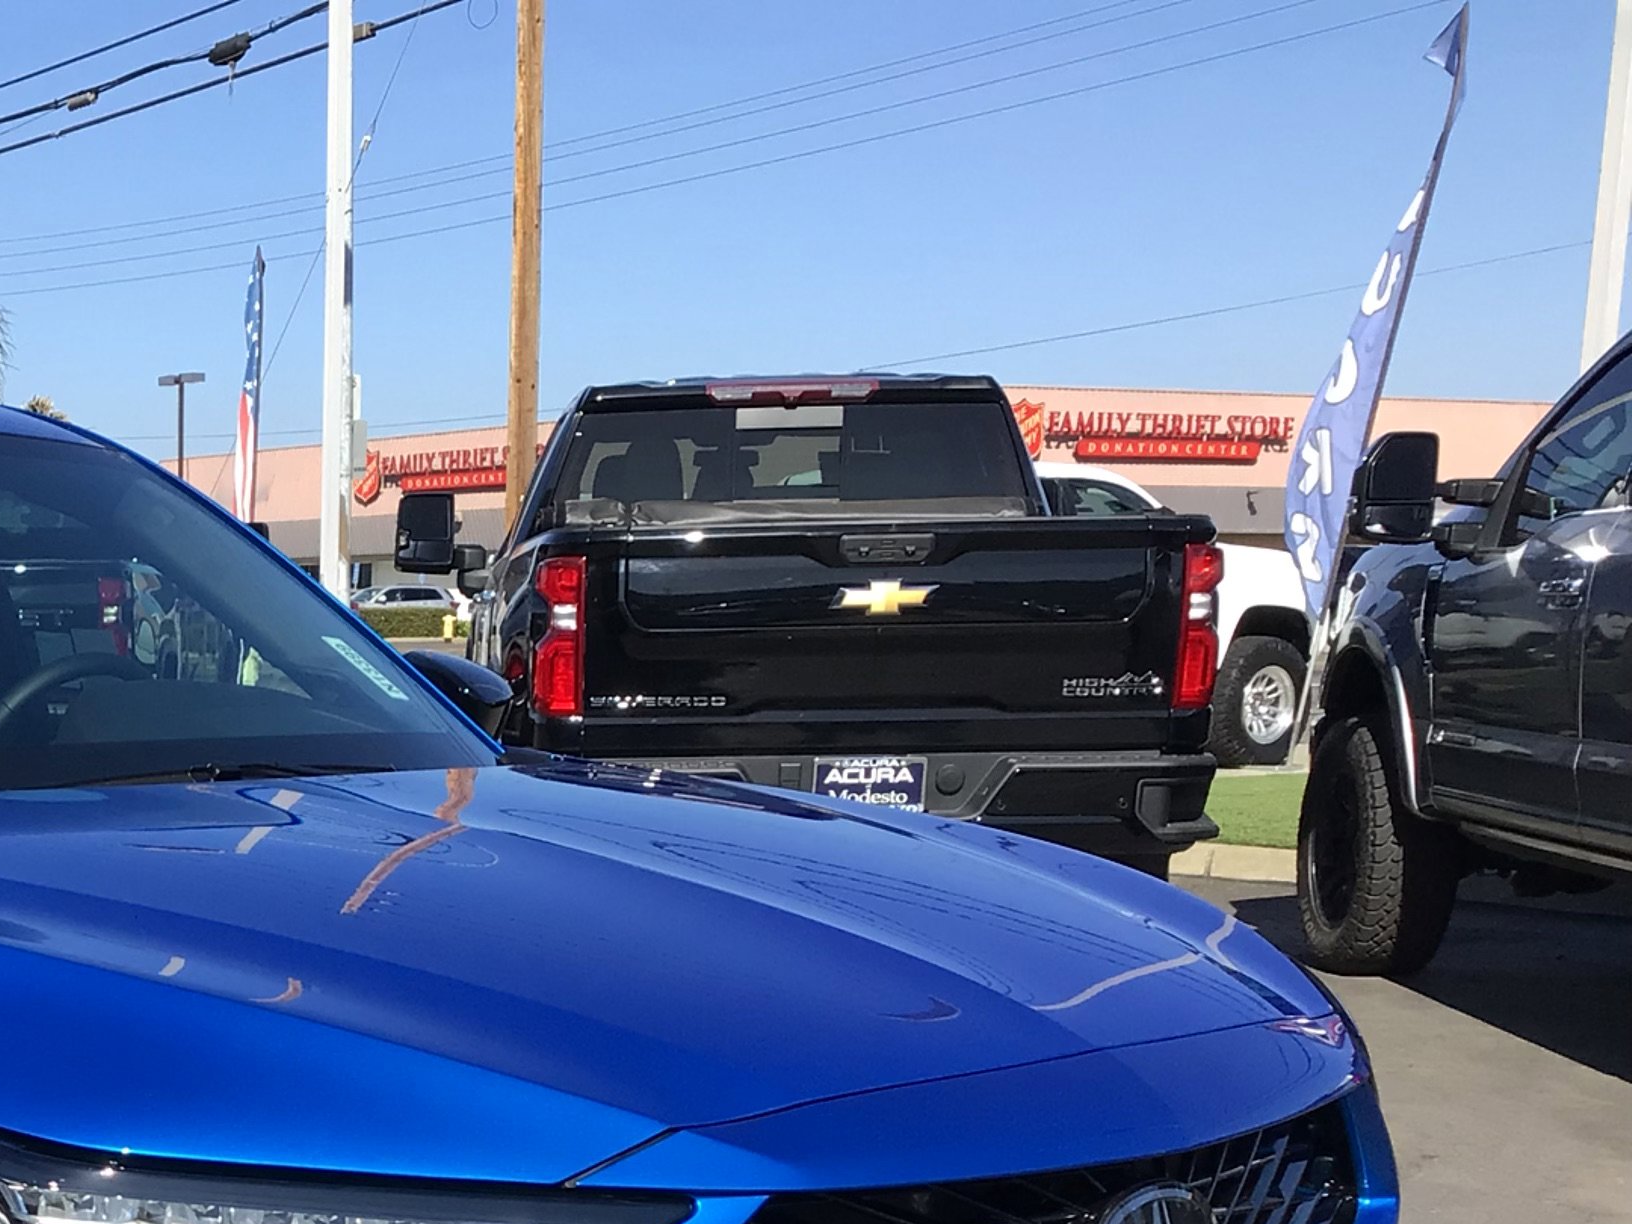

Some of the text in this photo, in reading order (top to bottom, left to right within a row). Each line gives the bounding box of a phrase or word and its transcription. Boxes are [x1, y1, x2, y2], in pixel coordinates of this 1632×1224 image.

[1049, 411, 1131, 434] FAMILY
[1136, 412, 1221, 438] THRIFT
[1227, 414, 1295, 440] STORE
[1087, 442, 1249, 456] DONATION CENTER
[382, 453, 433, 475] FAMILY
[438, 446, 498, 472] THRIFT
[407, 470, 506, 489] DONATION CENT
[823, 767, 915, 784] ACURA
